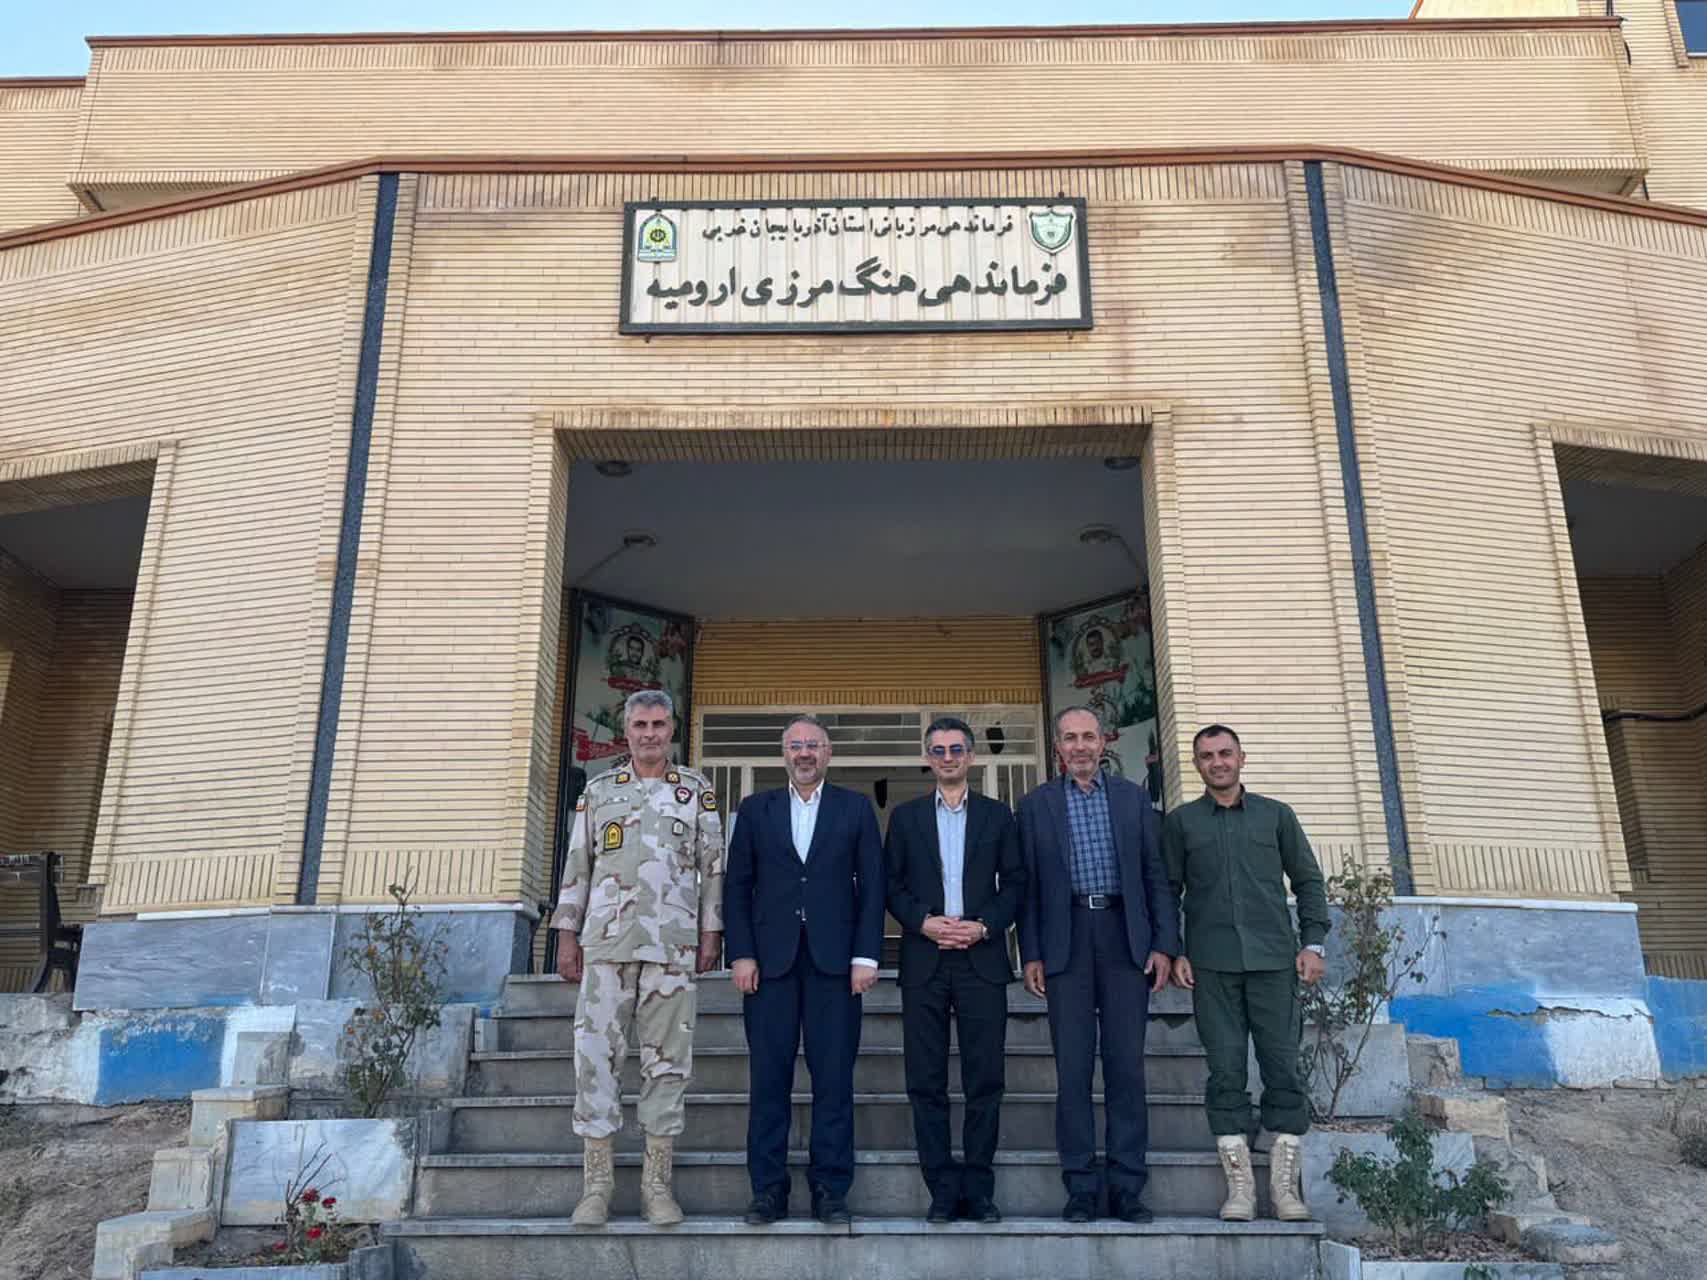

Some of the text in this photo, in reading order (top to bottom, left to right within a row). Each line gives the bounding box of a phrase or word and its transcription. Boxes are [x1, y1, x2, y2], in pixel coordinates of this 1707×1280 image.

[702, 212, 1013, 242] فرماندهی مرزبانی استان آذربایجان غربی
[646, 256, 1067, 310] فرماندهی هنگ مرزی ارومیه
